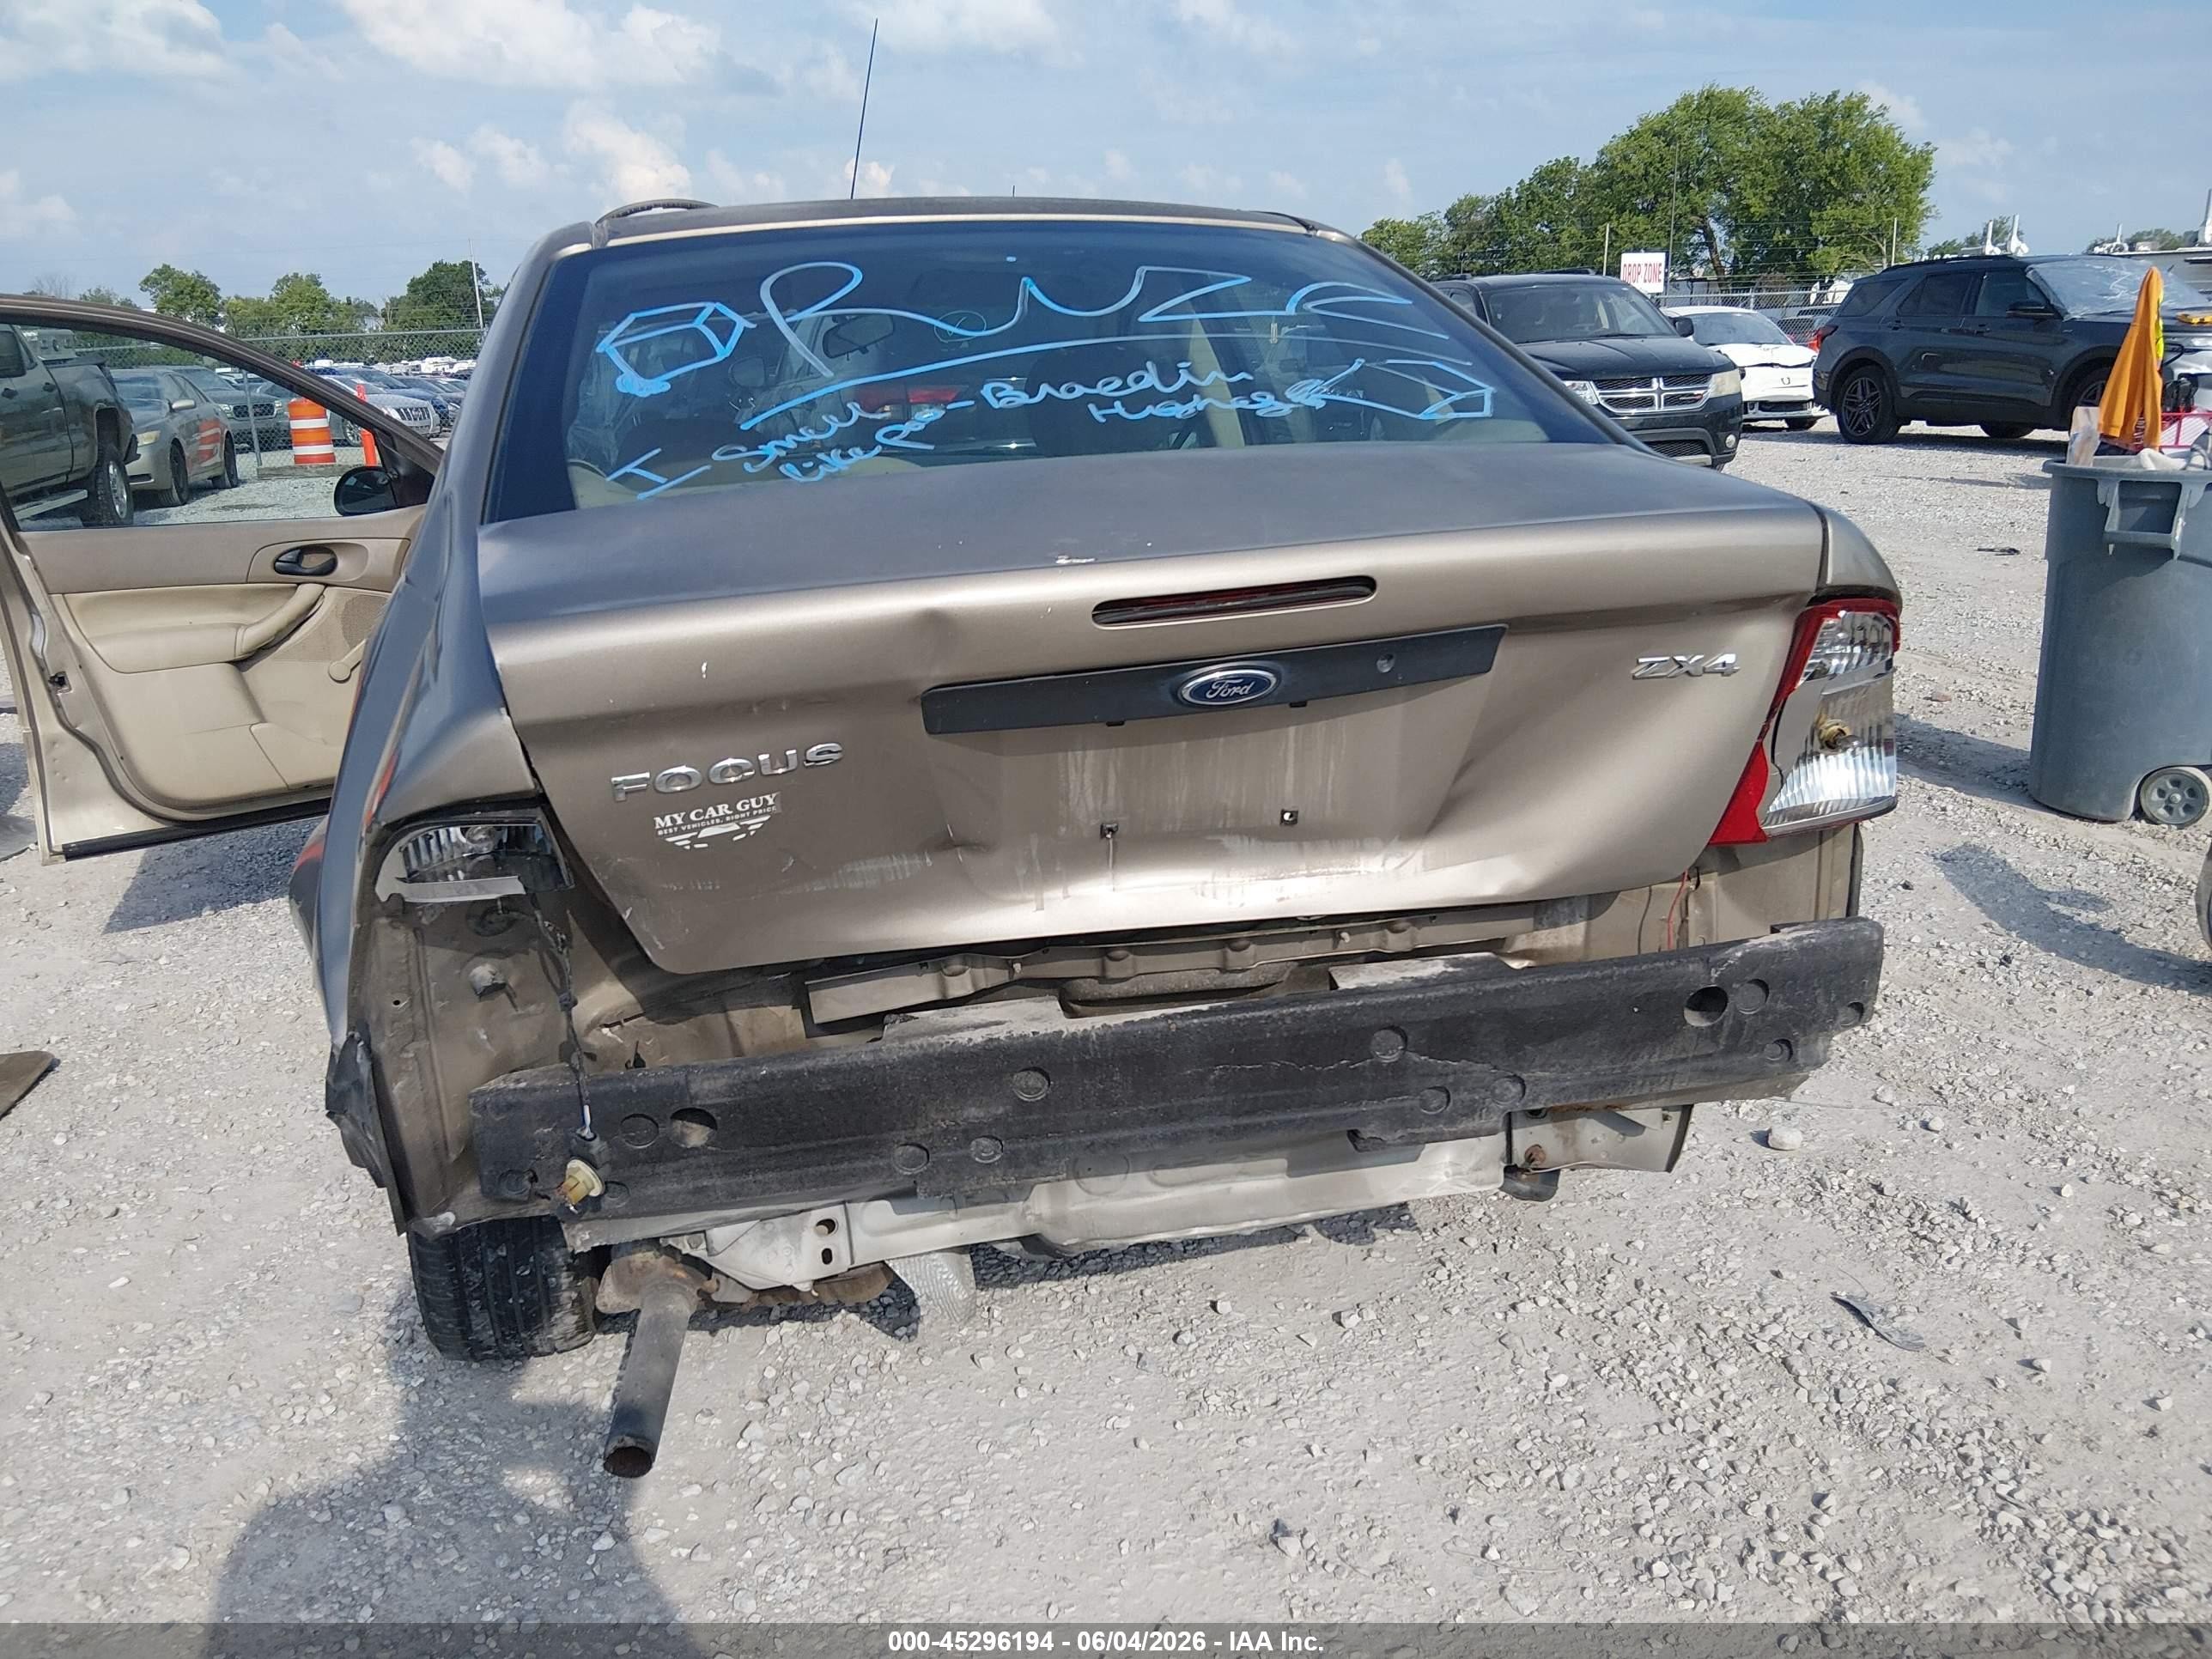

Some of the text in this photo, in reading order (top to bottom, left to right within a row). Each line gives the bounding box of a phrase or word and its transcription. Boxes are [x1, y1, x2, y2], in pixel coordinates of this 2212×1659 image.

[1623, 262, 1662, 283] DROP ZONE
[1632, 653, 1741, 680] ZX4
[1206, 678, 1255, 698] Ford
[611, 742, 843, 802] FOCUS
[653, 792, 778, 830] MY CAR GUY
